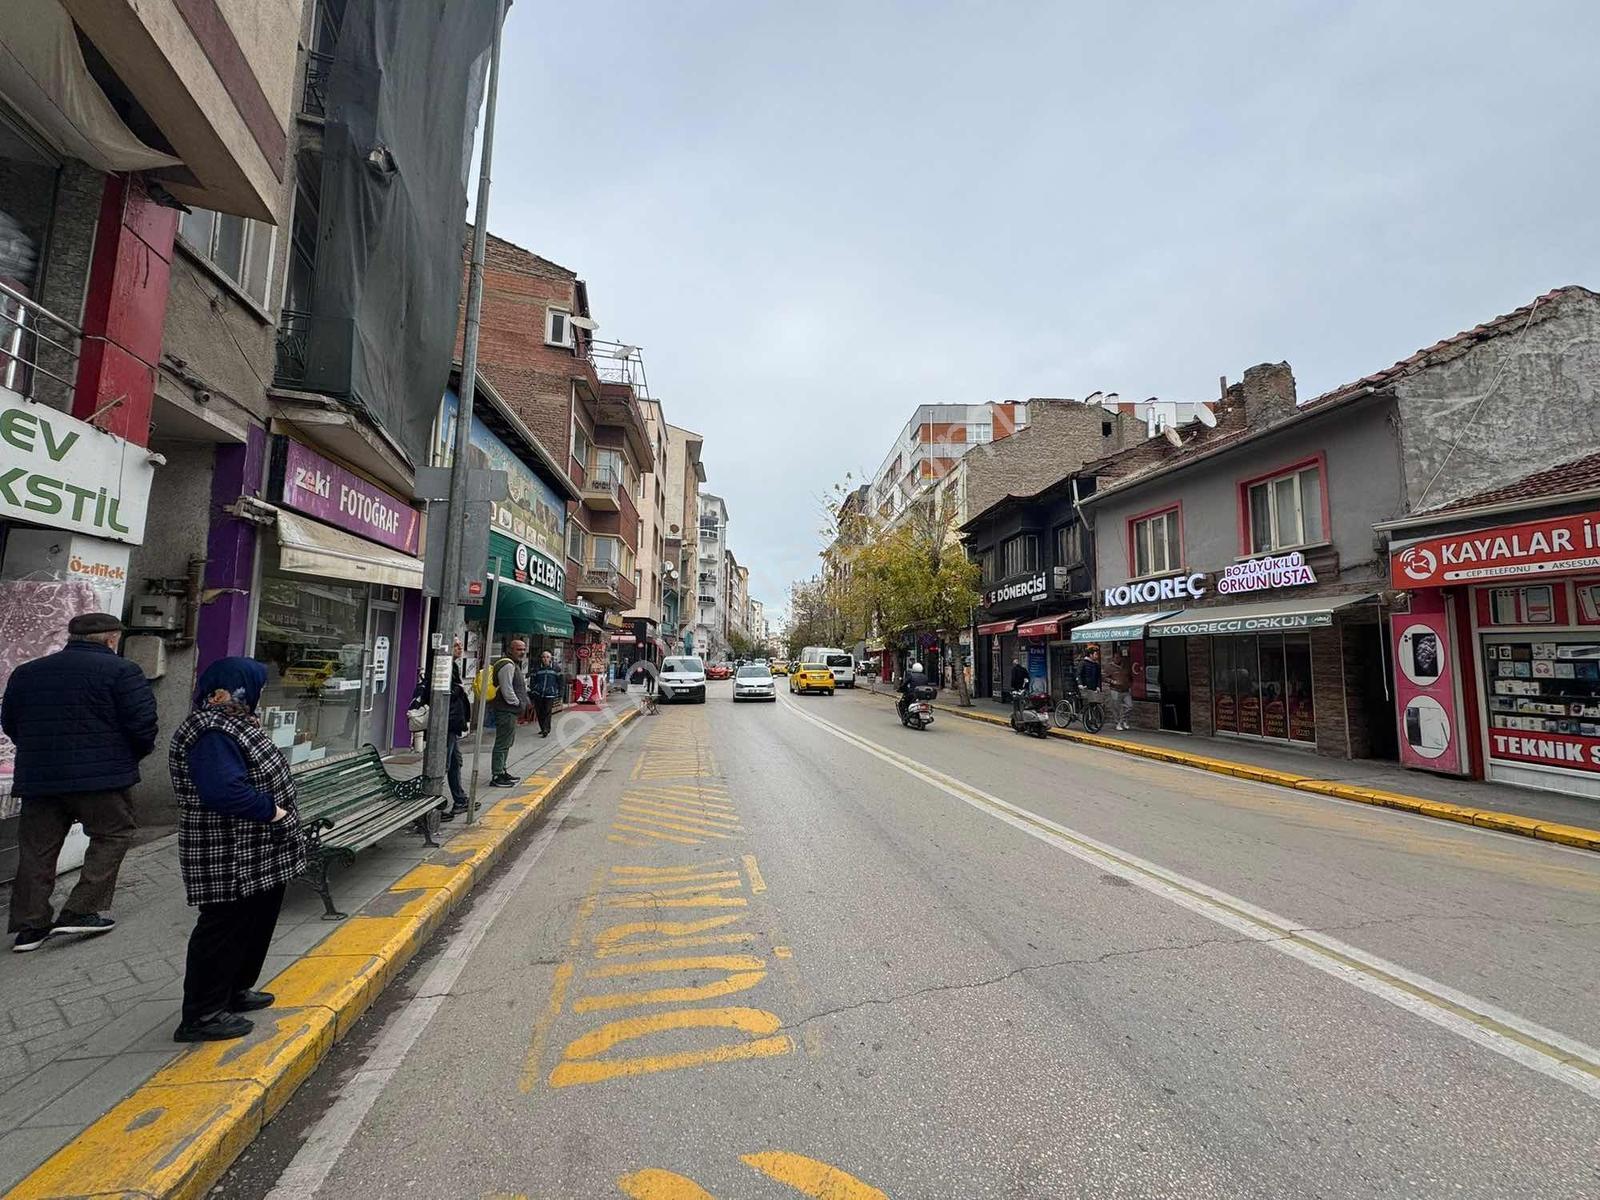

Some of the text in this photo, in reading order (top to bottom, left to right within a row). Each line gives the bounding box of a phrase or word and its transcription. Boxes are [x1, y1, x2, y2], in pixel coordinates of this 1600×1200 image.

[0, 408, 81, 462] EV
[339, 484, 400, 535] FOTOĞRAF
[1441, 528, 1574, 565] KAYALAR
[997, 571, 1047, 602] DÖNERCİSİ
[1218, 566, 1312, 594] ORKUN USTA
[1466, 568, 1484, 578] CEP
[1484, 565, 1531, 577] TELEFONU
[1104, 572, 1207, 607] KOKOREÇ
[1245, 615, 1308, 629] ORKUN
